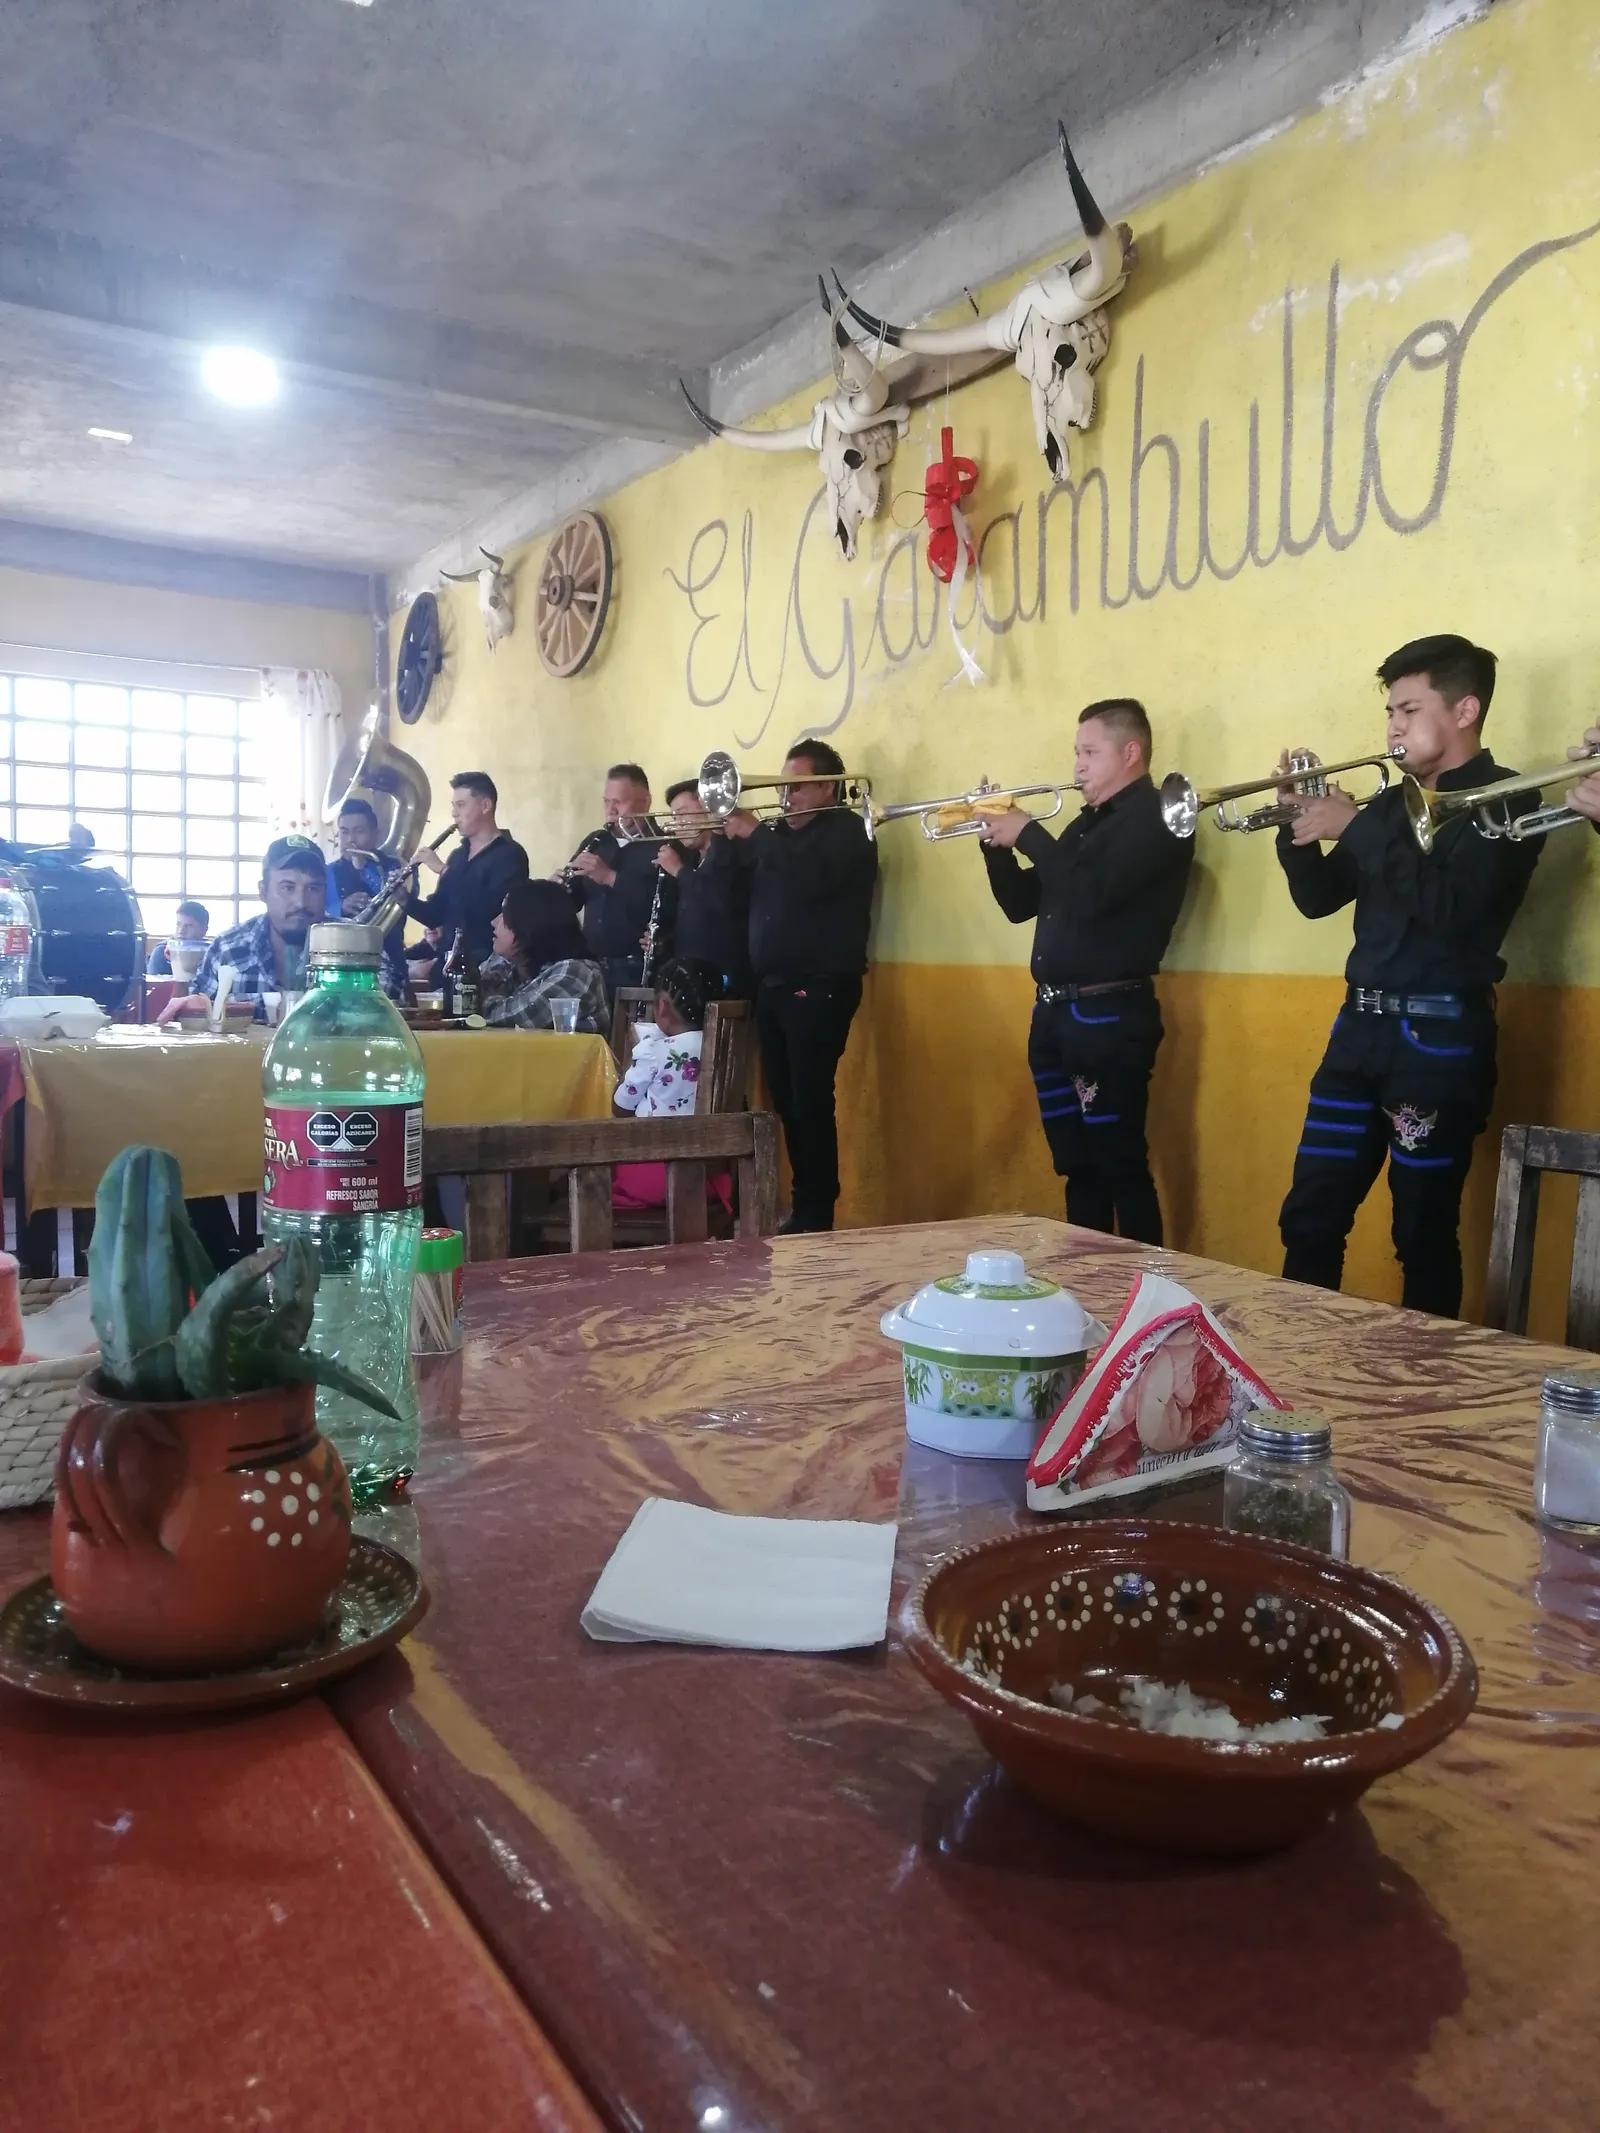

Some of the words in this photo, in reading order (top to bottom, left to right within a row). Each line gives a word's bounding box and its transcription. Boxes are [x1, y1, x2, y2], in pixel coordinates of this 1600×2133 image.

[663, 508, 767, 707] El
[733, 225, 1600, 750] Gaambullo
[351, 1177, 367, 1187] 600
[368, 1176, 378, 1186] ml
[326, 1190, 358, 1200] REFRESCO
[359, 1189, 379, 1200] SABOR
